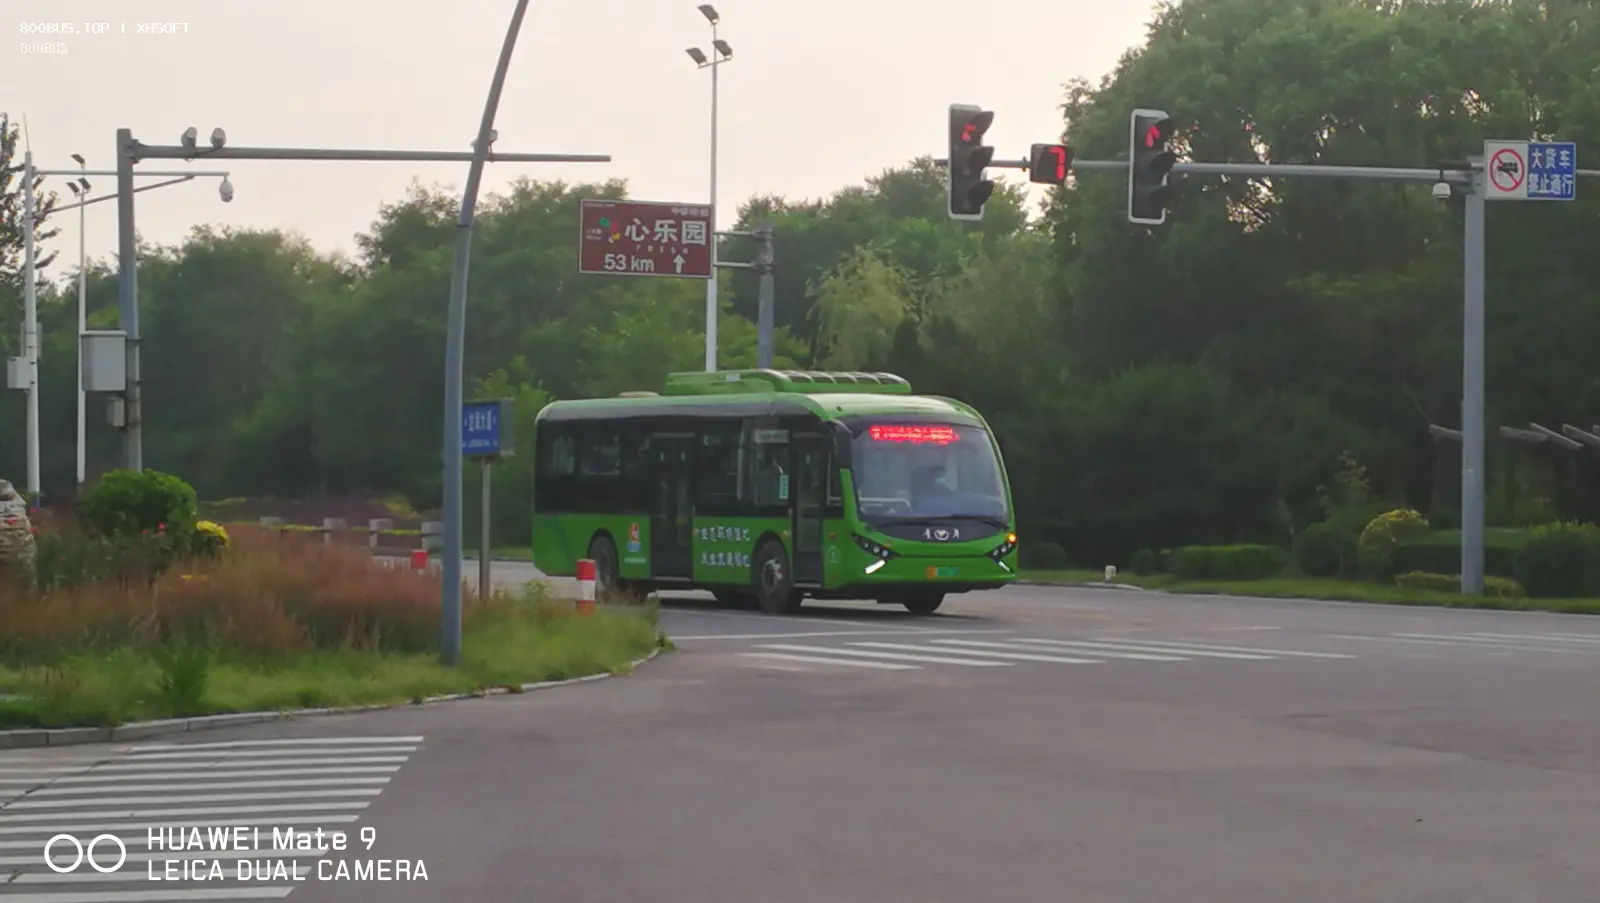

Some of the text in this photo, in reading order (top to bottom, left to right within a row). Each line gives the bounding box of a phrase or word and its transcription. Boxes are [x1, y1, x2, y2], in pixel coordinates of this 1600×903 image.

[1528, 173, 1573, 195] 禁止通行
[603, 253, 655, 272] 53 km
